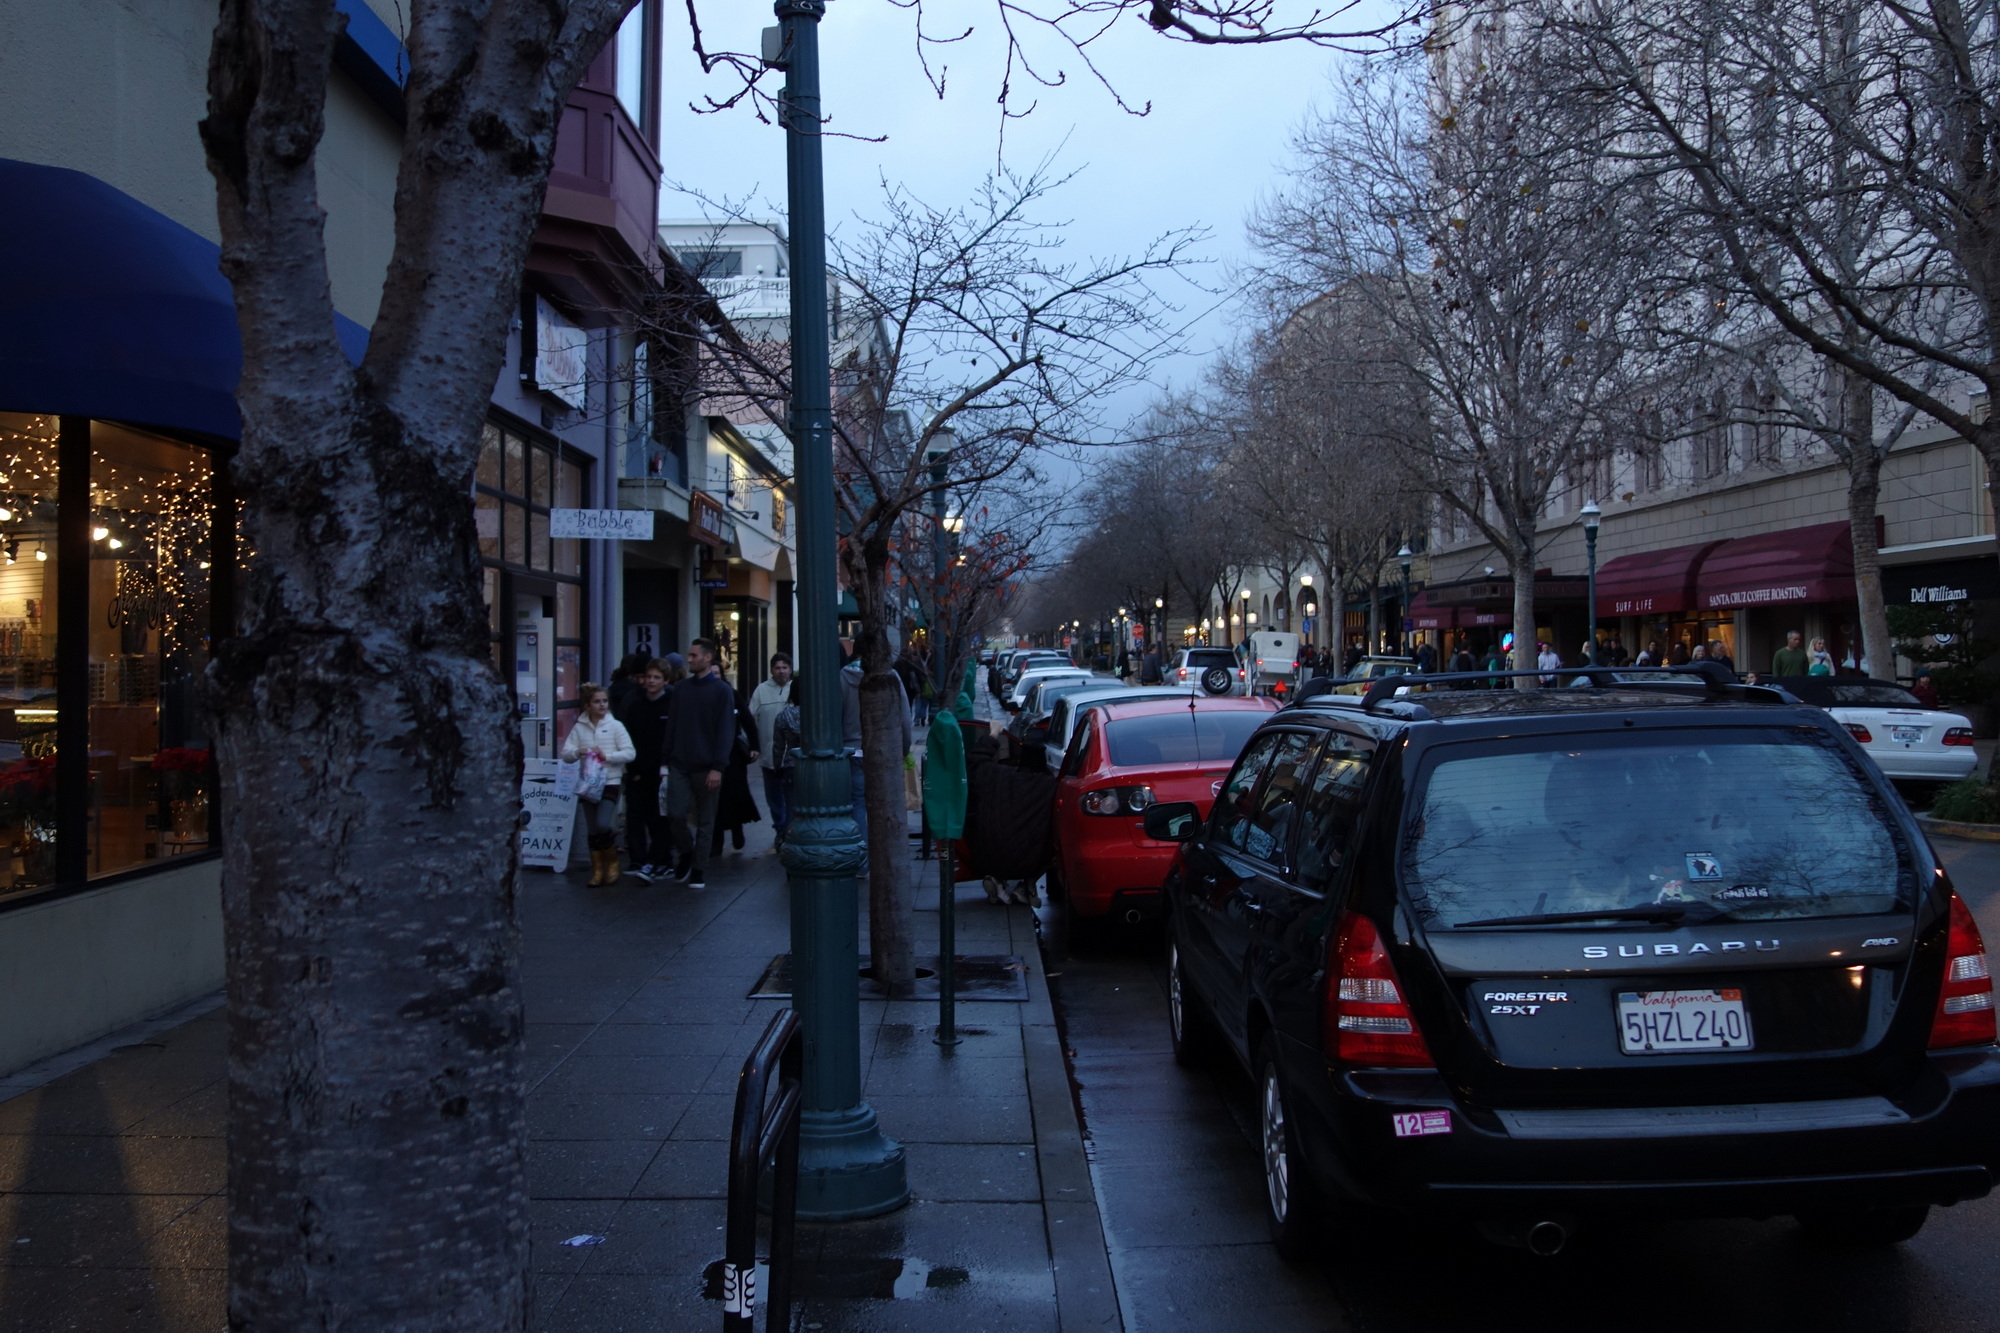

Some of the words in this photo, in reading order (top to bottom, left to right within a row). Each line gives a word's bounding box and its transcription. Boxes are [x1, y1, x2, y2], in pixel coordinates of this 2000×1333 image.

[574, 510, 633, 529] Bubble
[1709, 593, 1730, 607] SANTA
[1730, 591, 1747, 605] CRUZ
[1747, 589, 1770, 603] COFFEE
[1771, 586, 1807, 601] ROASTING
[1928, 585, 1968, 602] Williams
[1615, 600, 1631, 612] SURF
[1636, 598, 1652, 611] LIFE
[1583, 939, 1781, 960] SUBARU
[1861, 937, 1899, 949] AWD
[1483, 991, 1569, 1003] FORESTER
[1642, 989, 1722, 1009] California
[1626, 1010, 1742, 1044] 5HZL240
[1397, 1114, 1420, 1135] 12
